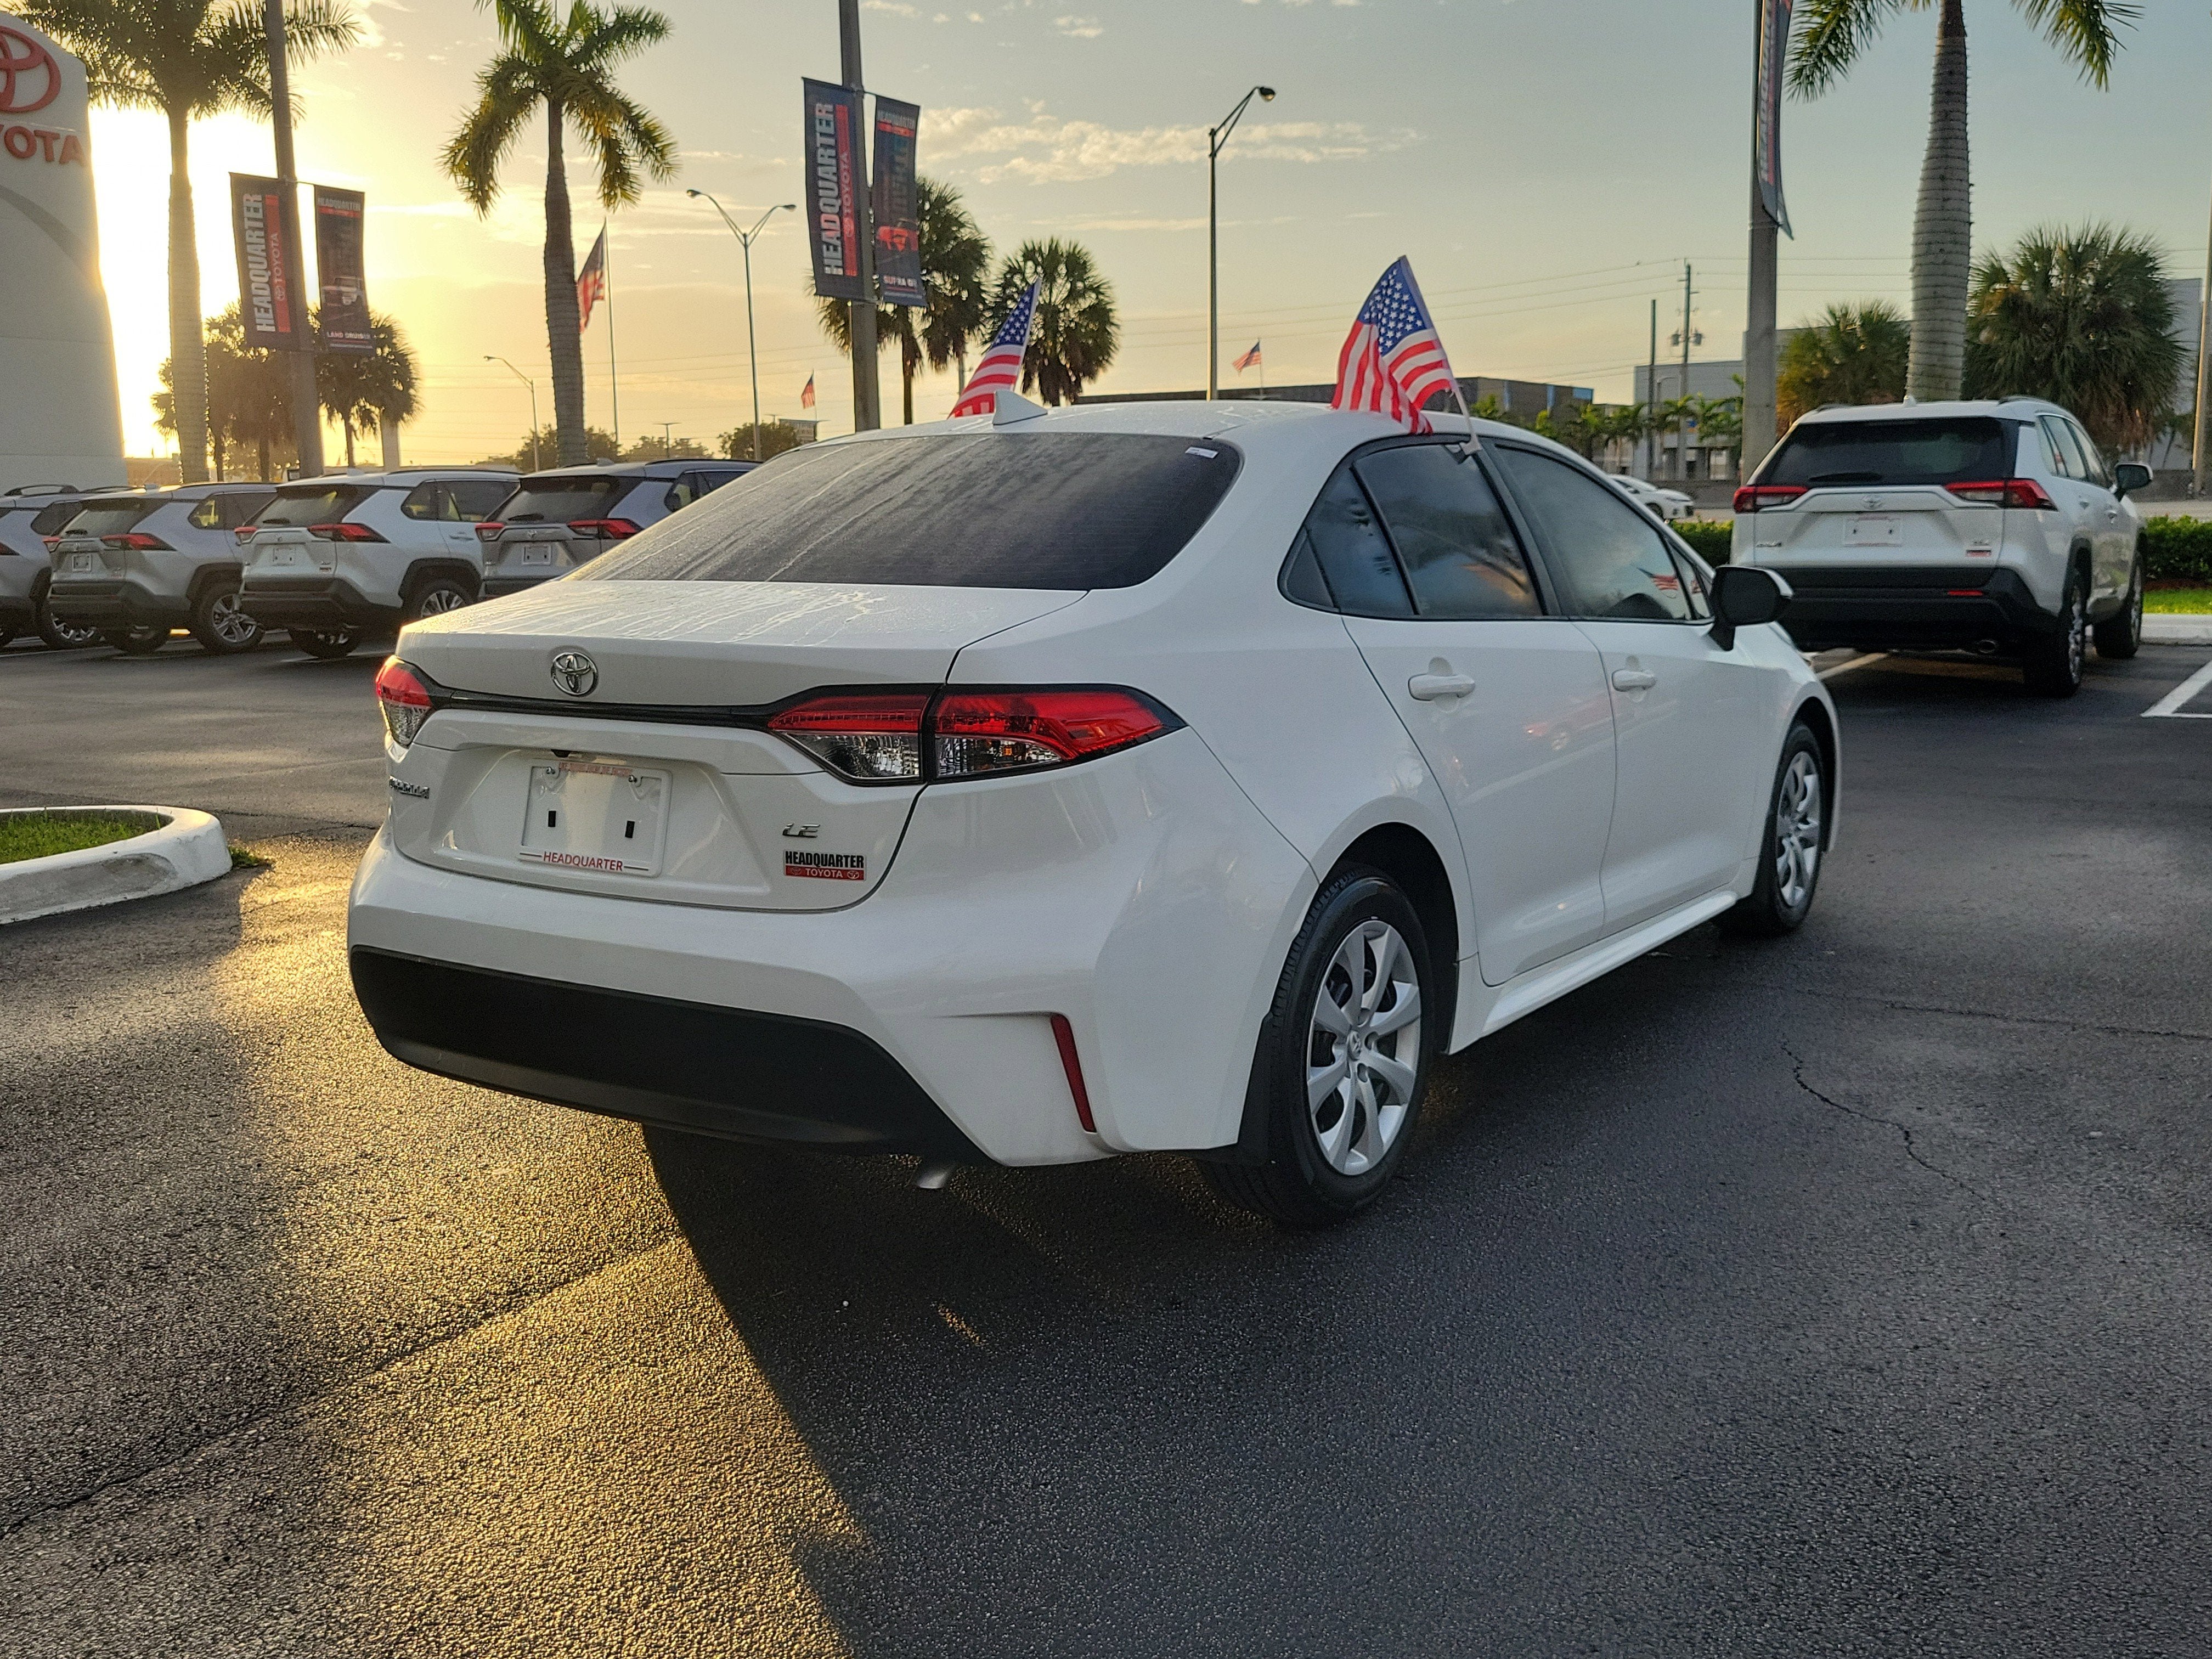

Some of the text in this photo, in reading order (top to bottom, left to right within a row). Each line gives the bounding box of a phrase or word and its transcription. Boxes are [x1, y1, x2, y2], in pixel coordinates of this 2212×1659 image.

[0, 124, 85, 167] OTA
[816, 103, 843, 275] HEADQUARTER
[840, 152, 853, 217] TOYOTA
[243, 193, 275, 332] HEADQUARTER
[270, 233, 284, 283] TOYOTA
[782, 823, 821, 838] LE
[543, 851, 623, 872] HEADQUARTER
[785, 850, 865, 868] HEADQUARTER
[805, 868, 843, 878] TOYOTA
